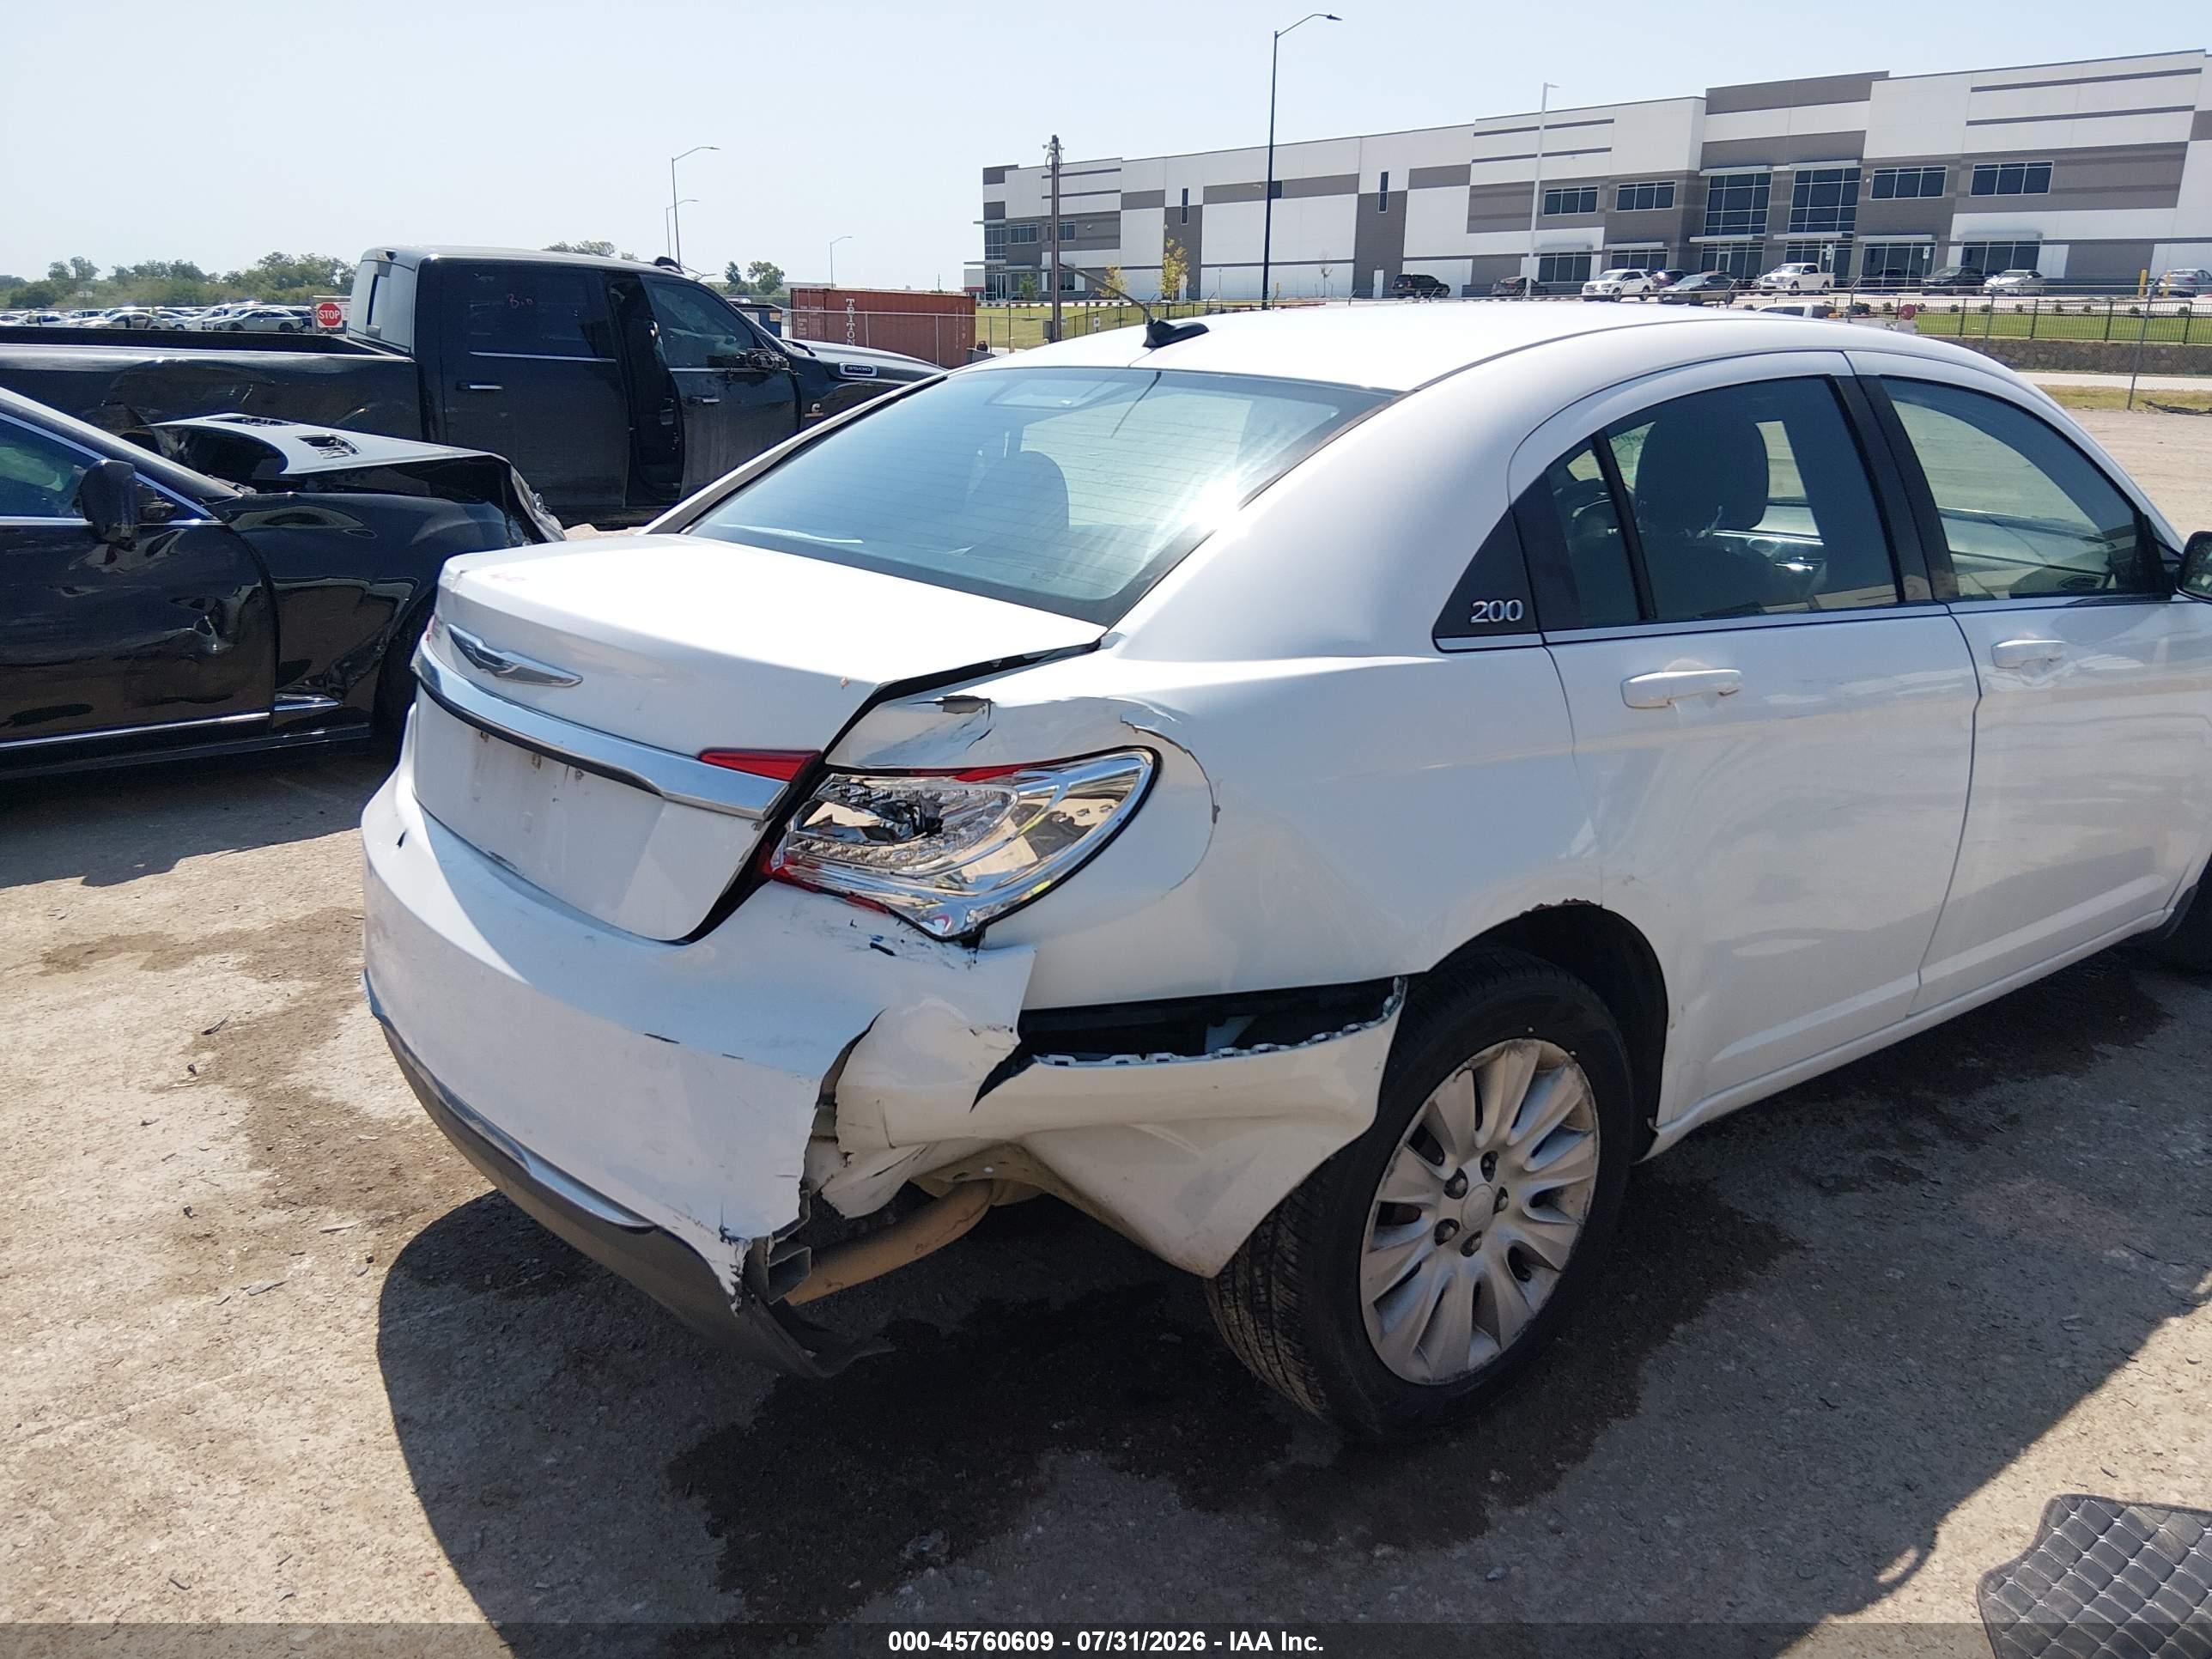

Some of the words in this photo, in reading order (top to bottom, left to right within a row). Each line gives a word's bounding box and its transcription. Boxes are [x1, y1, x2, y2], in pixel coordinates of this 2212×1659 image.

[319, 309, 340, 319] STOP
[846, 298, 855, 346] TRITON
[1470, 599, 1523, 623] 200
